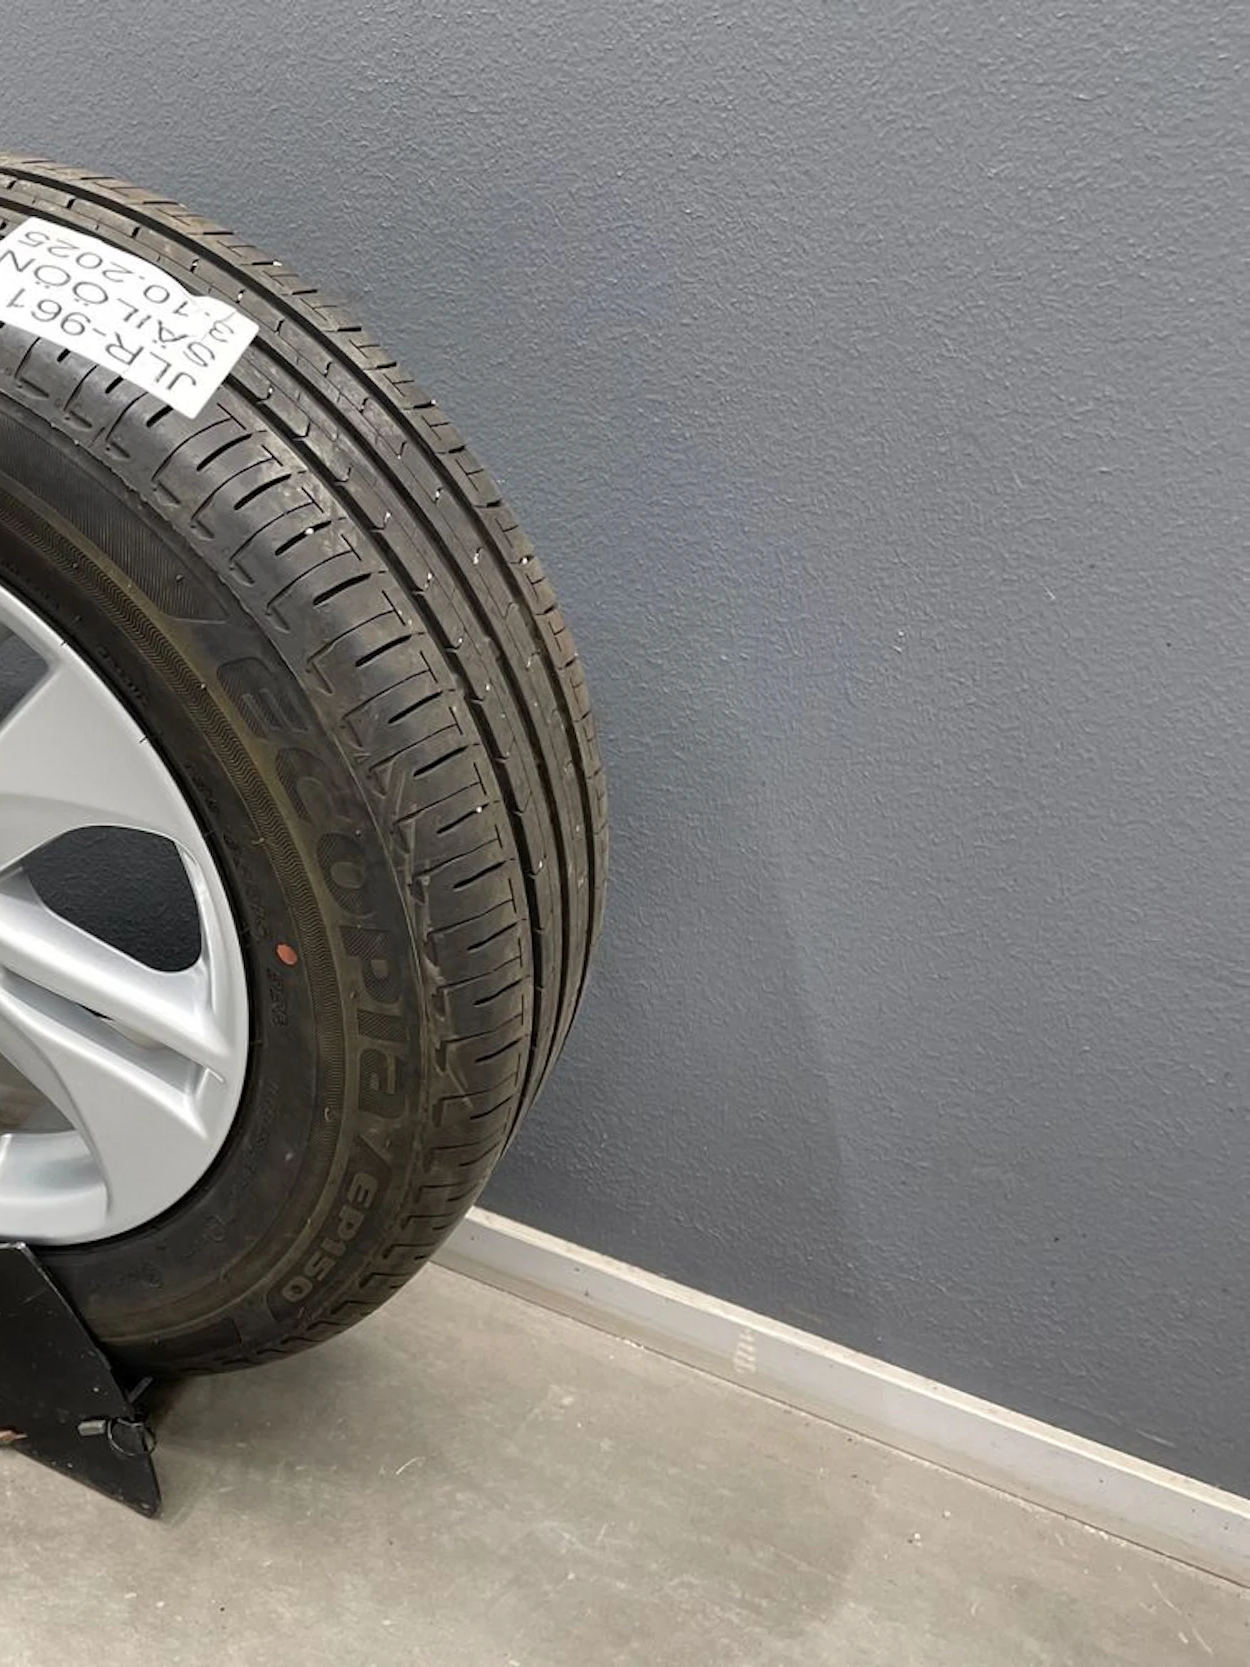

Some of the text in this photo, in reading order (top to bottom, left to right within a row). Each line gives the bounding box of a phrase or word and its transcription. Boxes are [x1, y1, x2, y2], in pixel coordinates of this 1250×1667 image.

[7, 288, 197, 391] JLR-961
[17, 230, 235, 343] 3.10.2025
[281, 1172, 379, 1303] EP150
